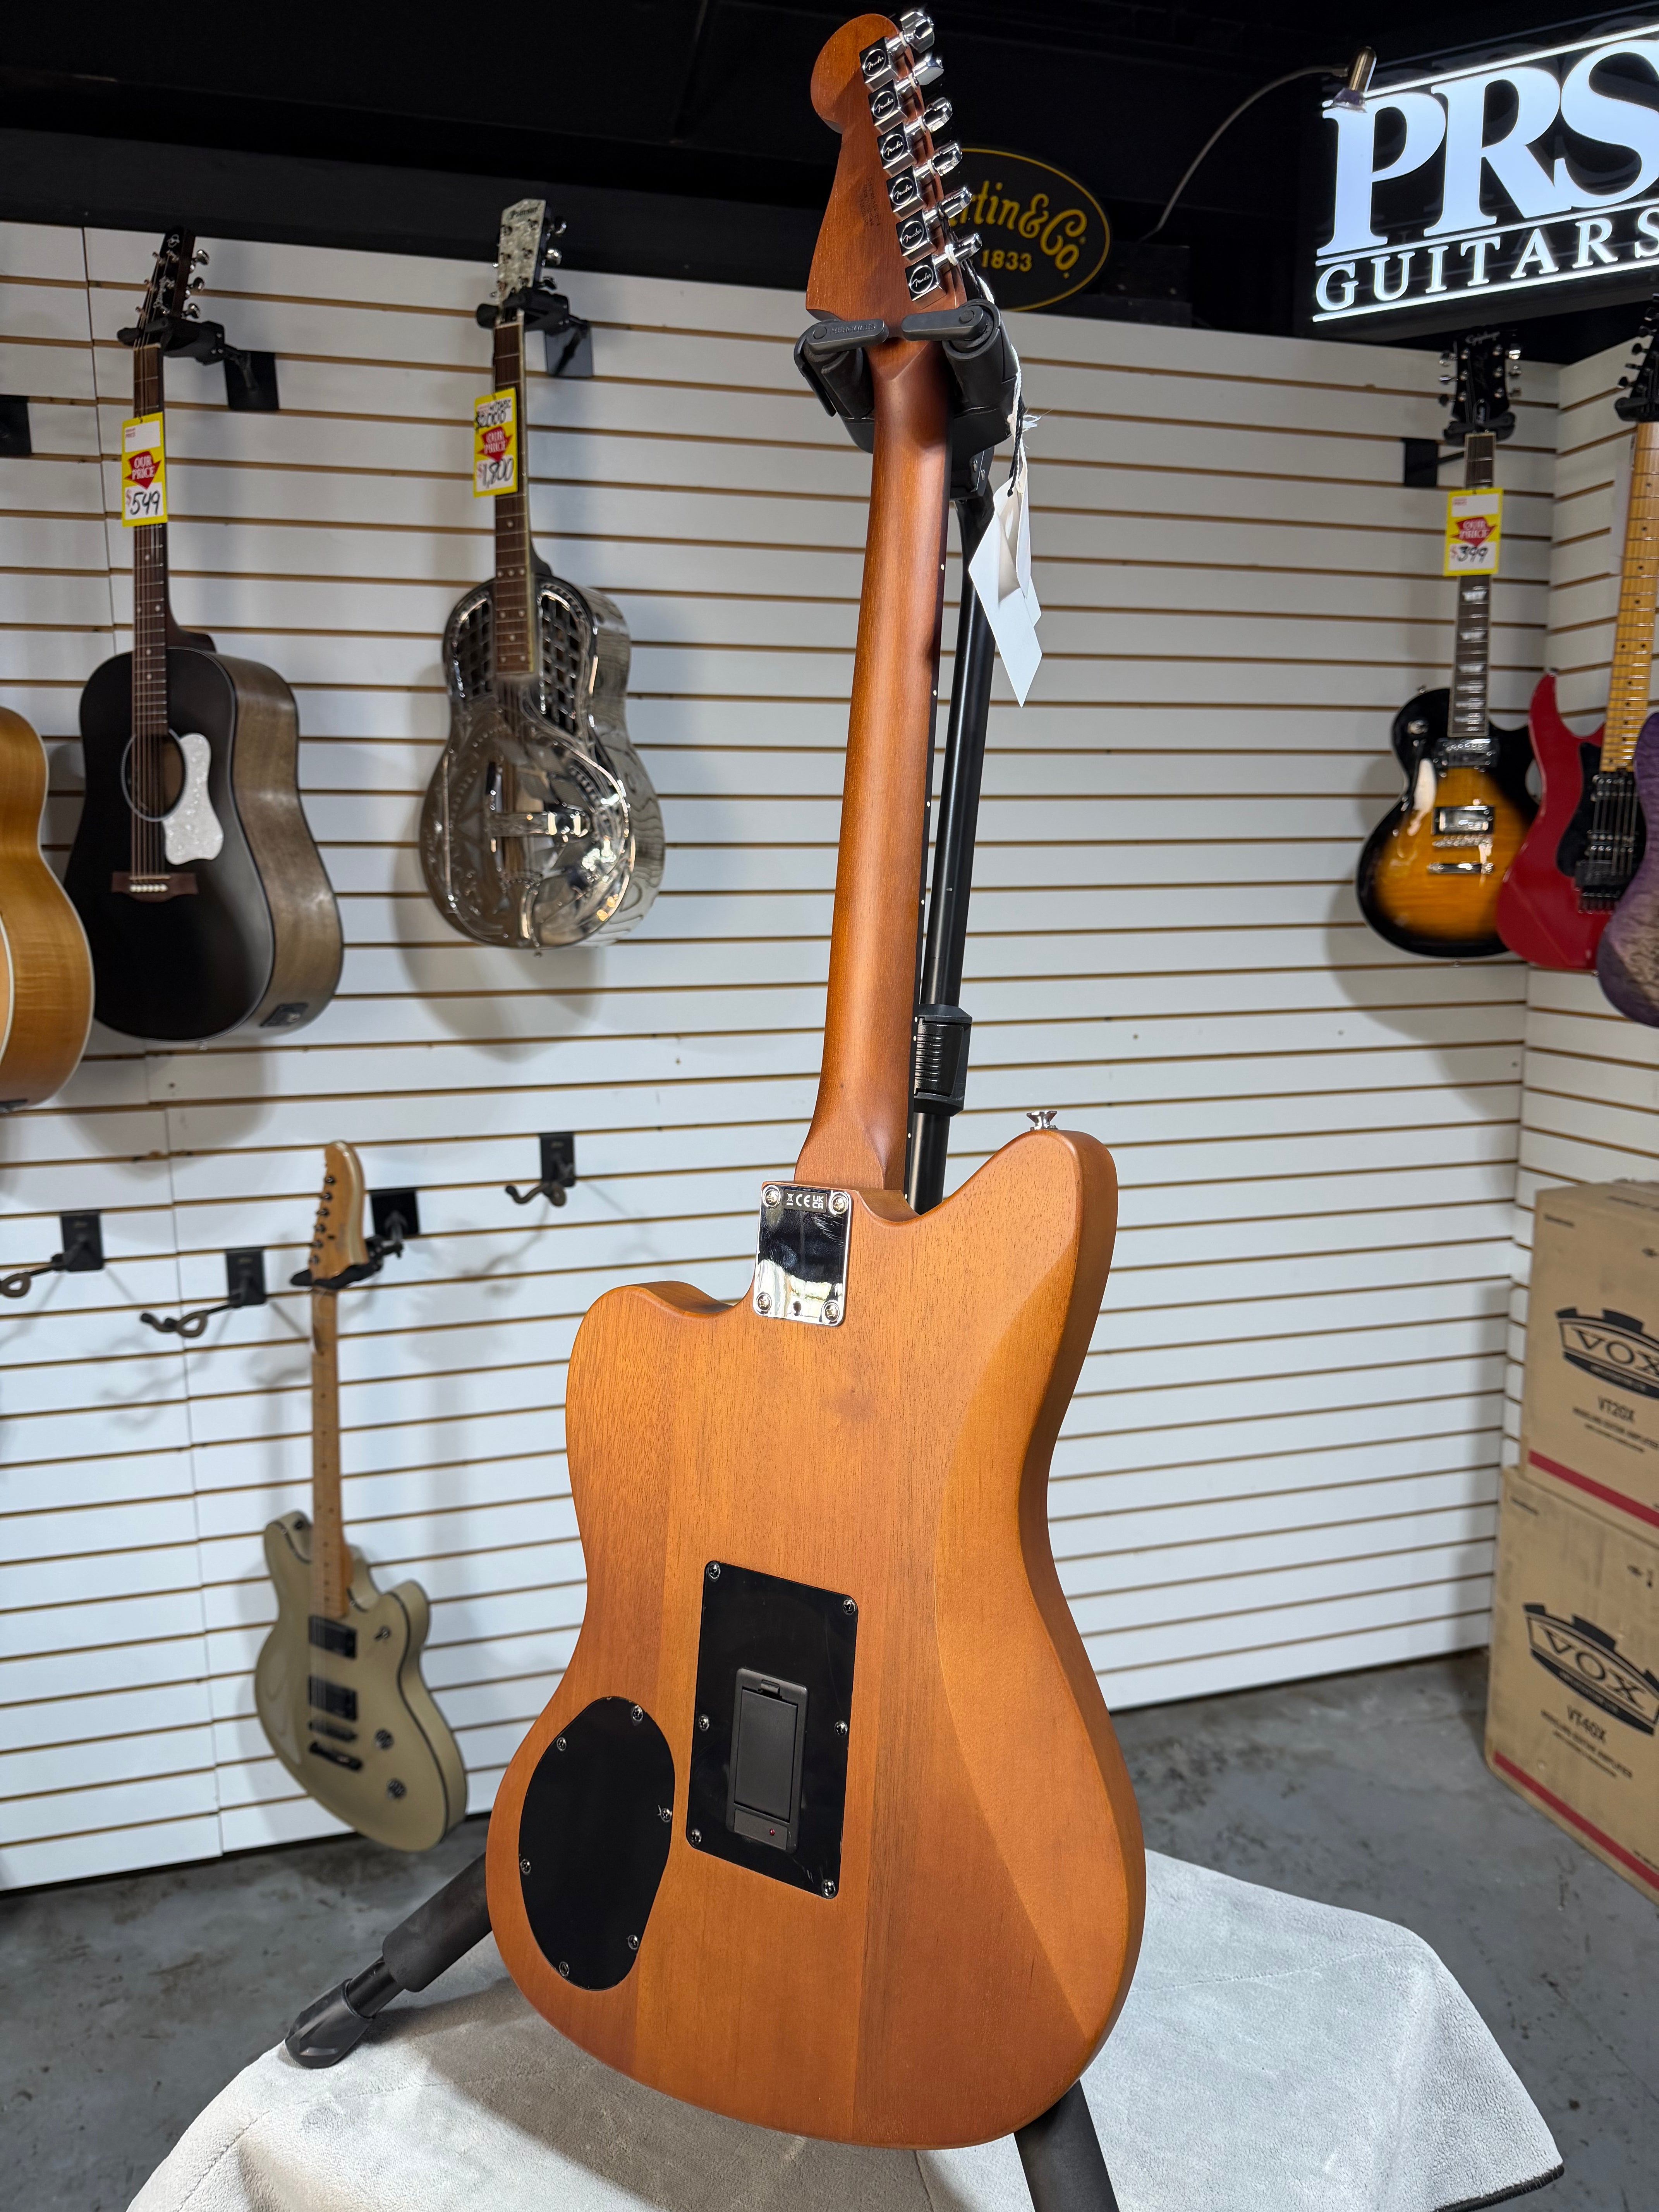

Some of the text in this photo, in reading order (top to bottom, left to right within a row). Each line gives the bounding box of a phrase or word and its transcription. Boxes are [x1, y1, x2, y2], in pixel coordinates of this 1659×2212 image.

[866, 56, 884, 70] Fender
[875, 98, 894, 113] Fender
[884, 141, 903, 156] Fender
[1317, 40, 1659, 256] PRS
[894, 184, 912, 199] Fender
[903, 228, 922, 243] Fender
[982, 249, 1032, 272] 1833
[1316, 207, 1659, 311] GUITARS
[912, 272, 931, 287] Fender
[486, 430, 504, 443] OUR
[484, 441, 505, 454] PRICE
[134, 455, 152, 469] OUR
[132, 465, 155, 480] PRICE
[1463, 519, 1486, 531] OUR
[1459, 529, 1490, 539] PRICE
[795, 1194, 811, 1208] CE
[1571, 1327, 1659, 1376] VOX
[1538, 1624, 1648, 1712] VOX
